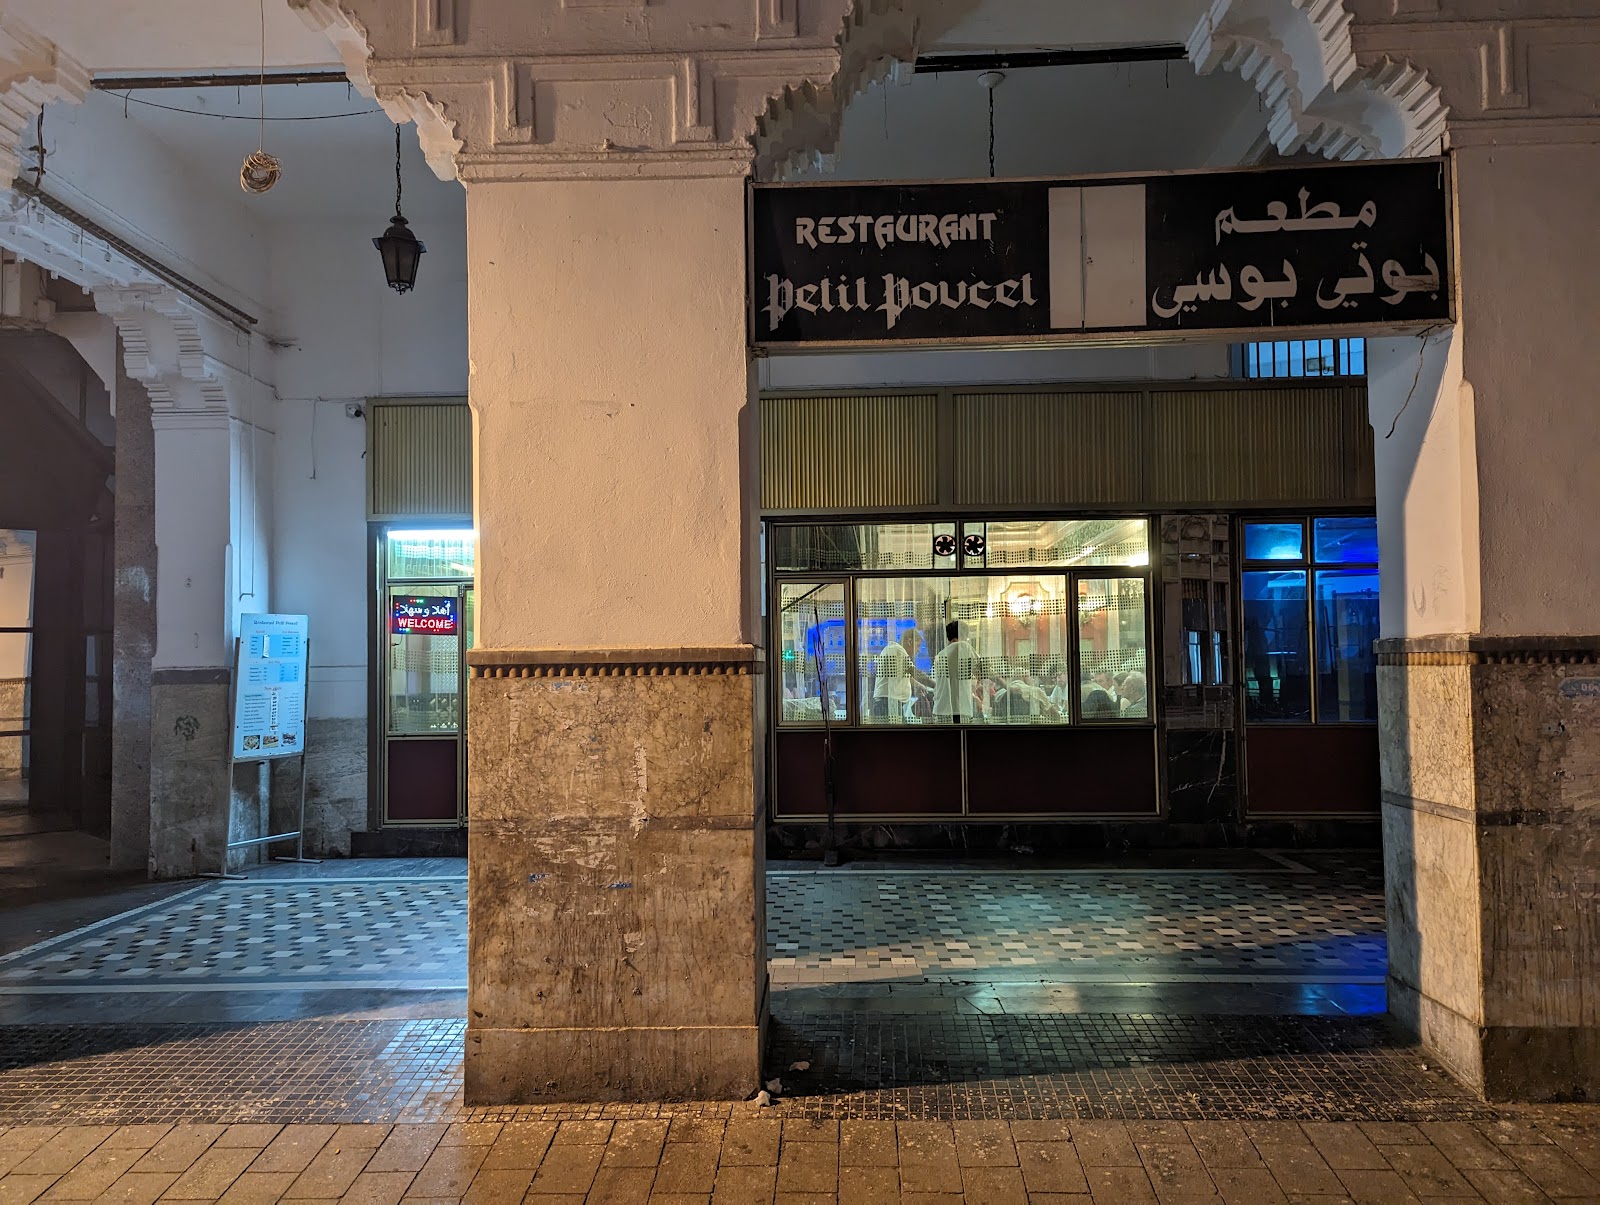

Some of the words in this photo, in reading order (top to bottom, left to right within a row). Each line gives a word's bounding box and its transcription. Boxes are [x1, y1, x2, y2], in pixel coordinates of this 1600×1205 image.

[796, 212, 997, 250] RESTAURANT
[1214, 185, 1377, 247] مطعم
[1151, 258, 1298, 319] بوسي
[1316, 240, 1440, 309] بوتي
[397, 618, 454, 629] WELCOME
